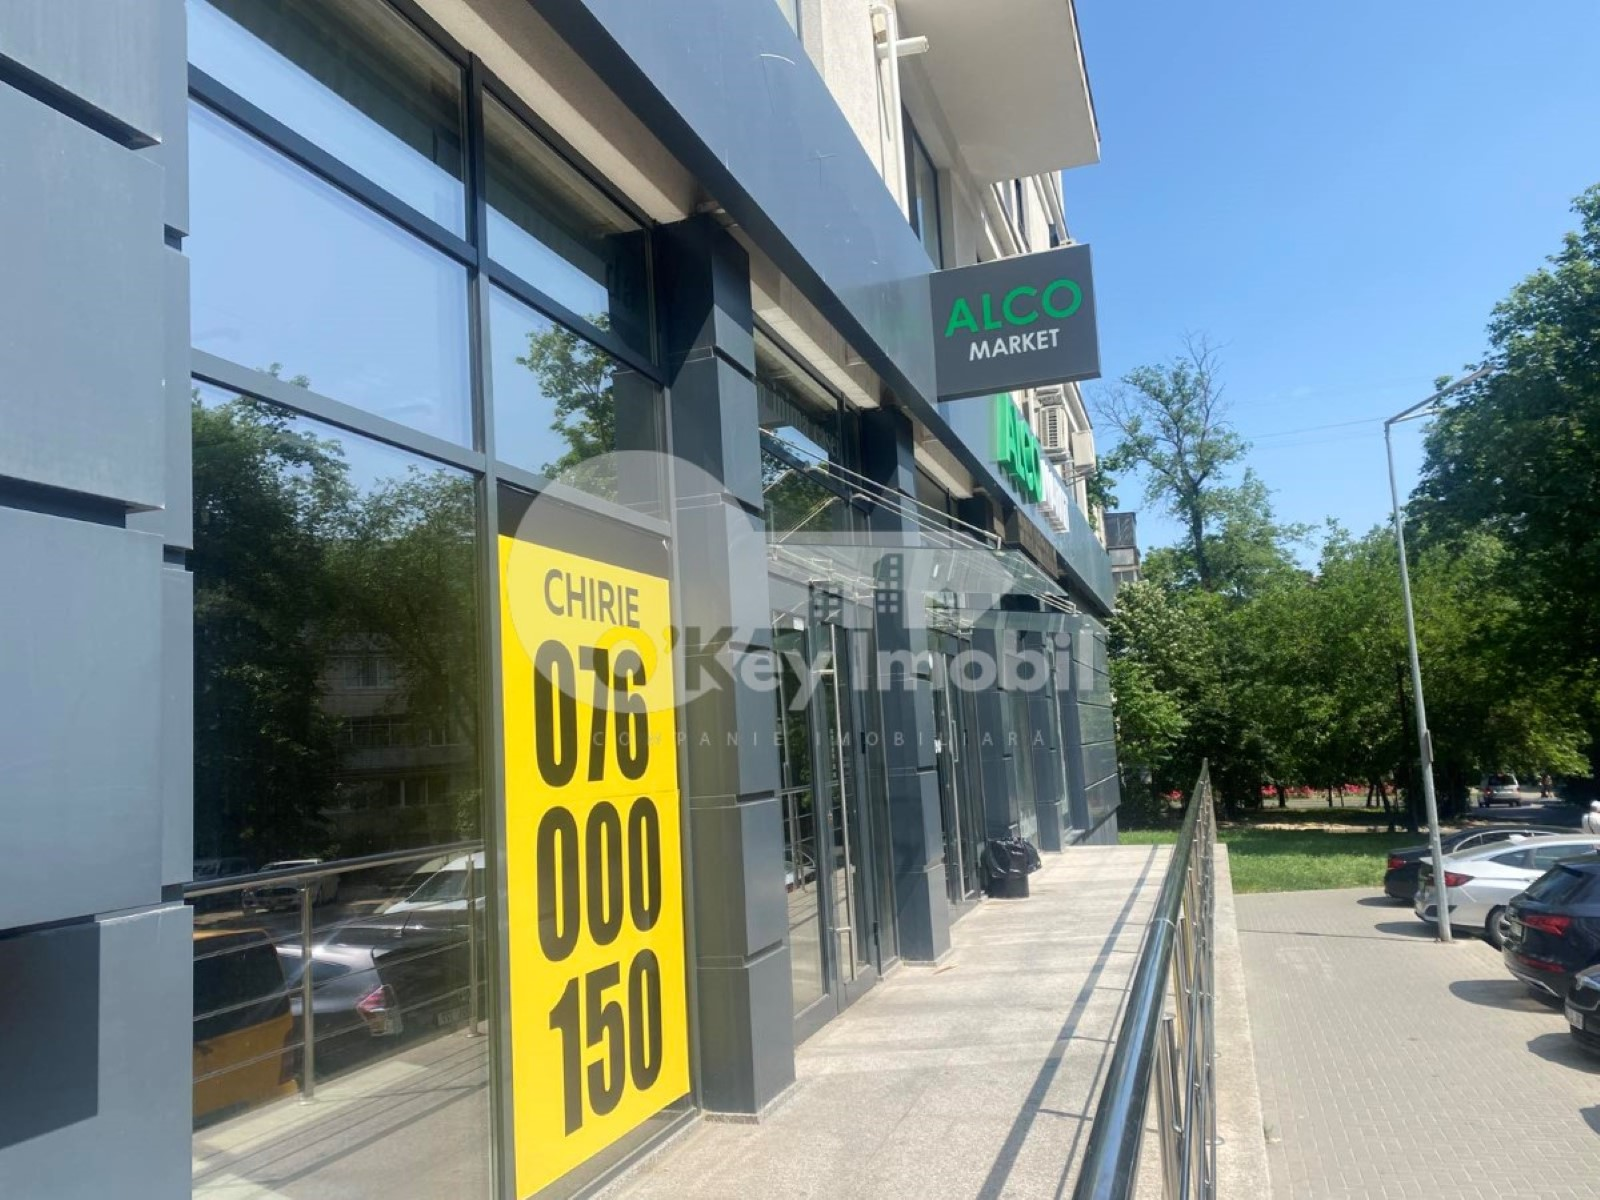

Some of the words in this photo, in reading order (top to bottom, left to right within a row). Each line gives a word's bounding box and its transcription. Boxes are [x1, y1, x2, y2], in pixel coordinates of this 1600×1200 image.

[945, 278, 1083, 337] ALCO
[969, 328, 1060, 361] MARKET
[544, 569, 640, 629] CHIRIE
[534, 639, 649, 788] 076
[537, 797, 662, 962] 000
[549, 949, 662, 1137] 150
